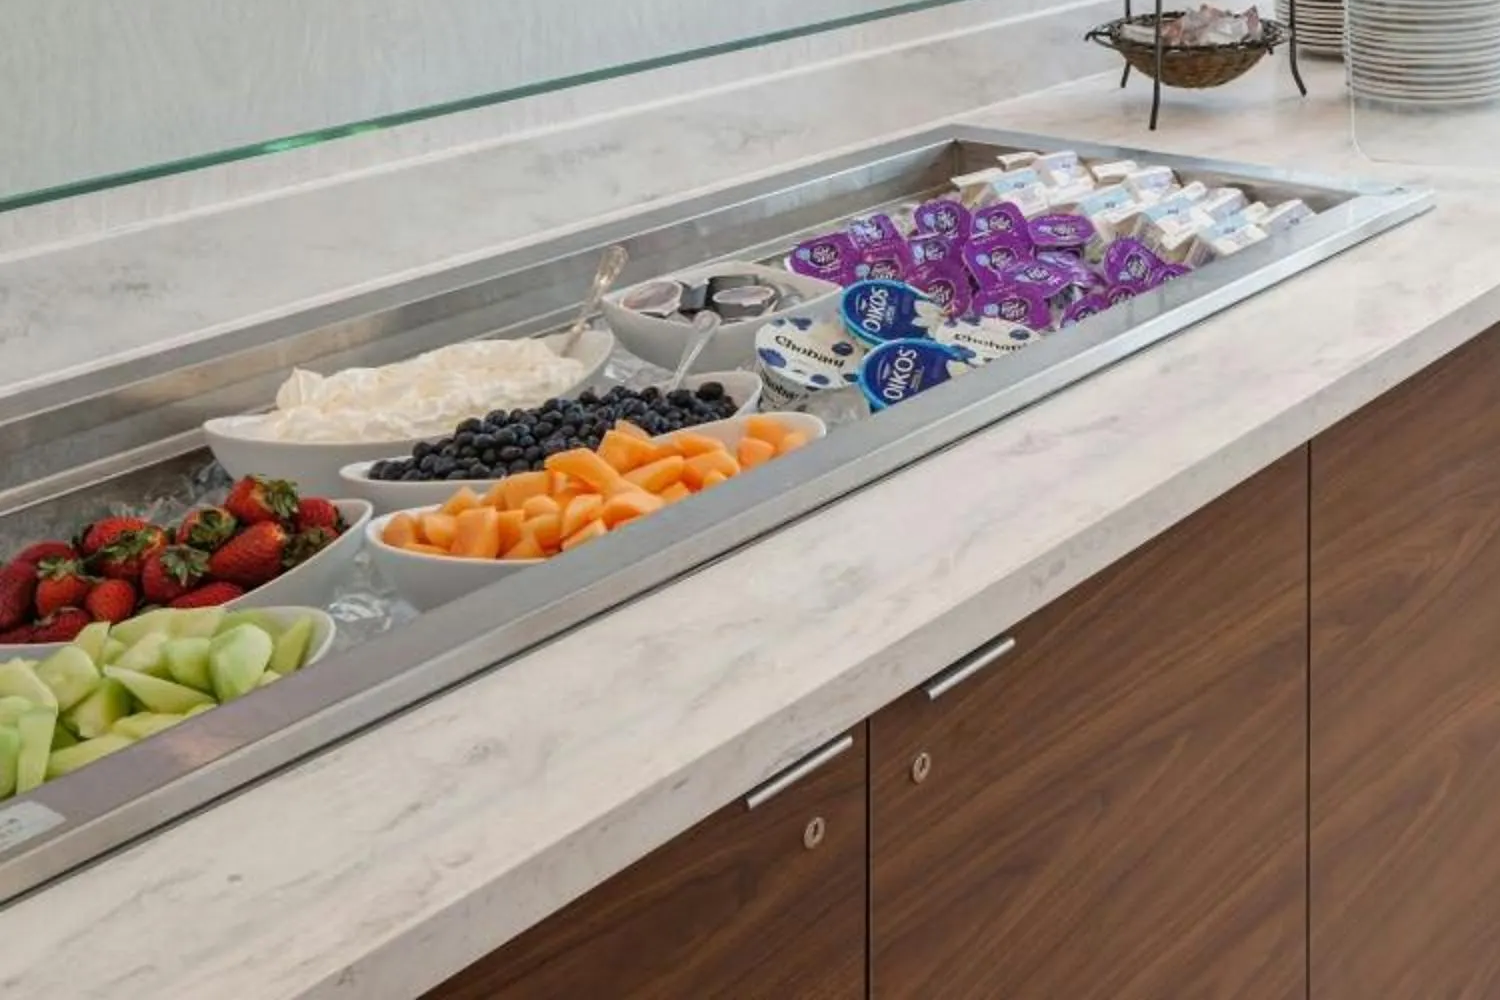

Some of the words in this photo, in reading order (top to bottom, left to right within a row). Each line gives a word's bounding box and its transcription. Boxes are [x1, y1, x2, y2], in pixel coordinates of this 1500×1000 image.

[861, 286, 889, 333] OIKOS
[774, 334, 846, 368] Chobani
[883, 348, 918, 400] OIKOS
